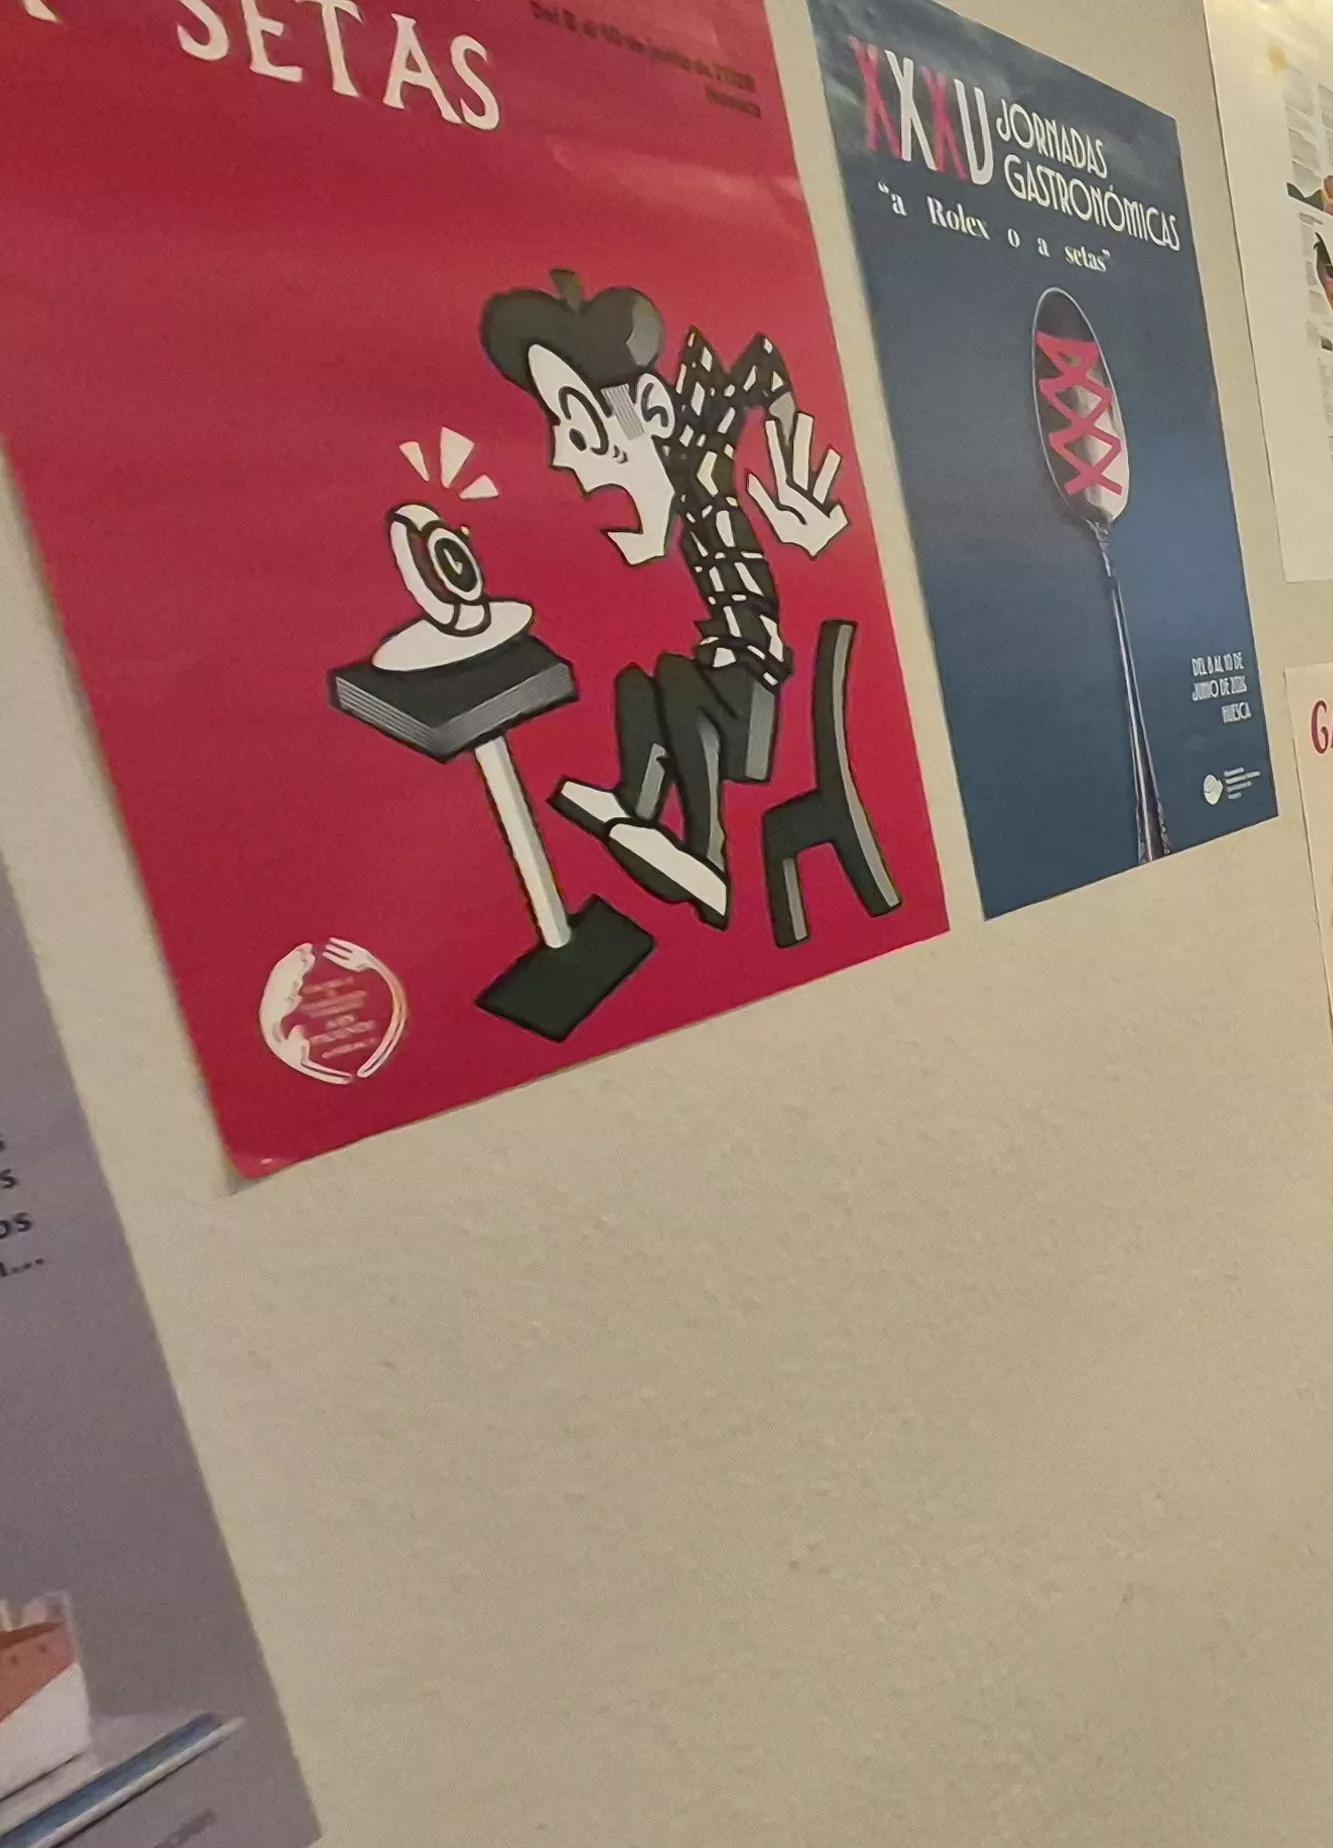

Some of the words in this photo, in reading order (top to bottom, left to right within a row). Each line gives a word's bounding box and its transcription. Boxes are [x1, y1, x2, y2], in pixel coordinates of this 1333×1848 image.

[177, 0, 499, 131] SETAS
[996, 99, 1108, 179] JORNADAS
[926, 196, 990, 240] Rolex
[1007, 228, 1021, 249] o
[1037, 237, 1051, 258] a
[1004, 154, 1180, 252] GASTRONÓMICAS
